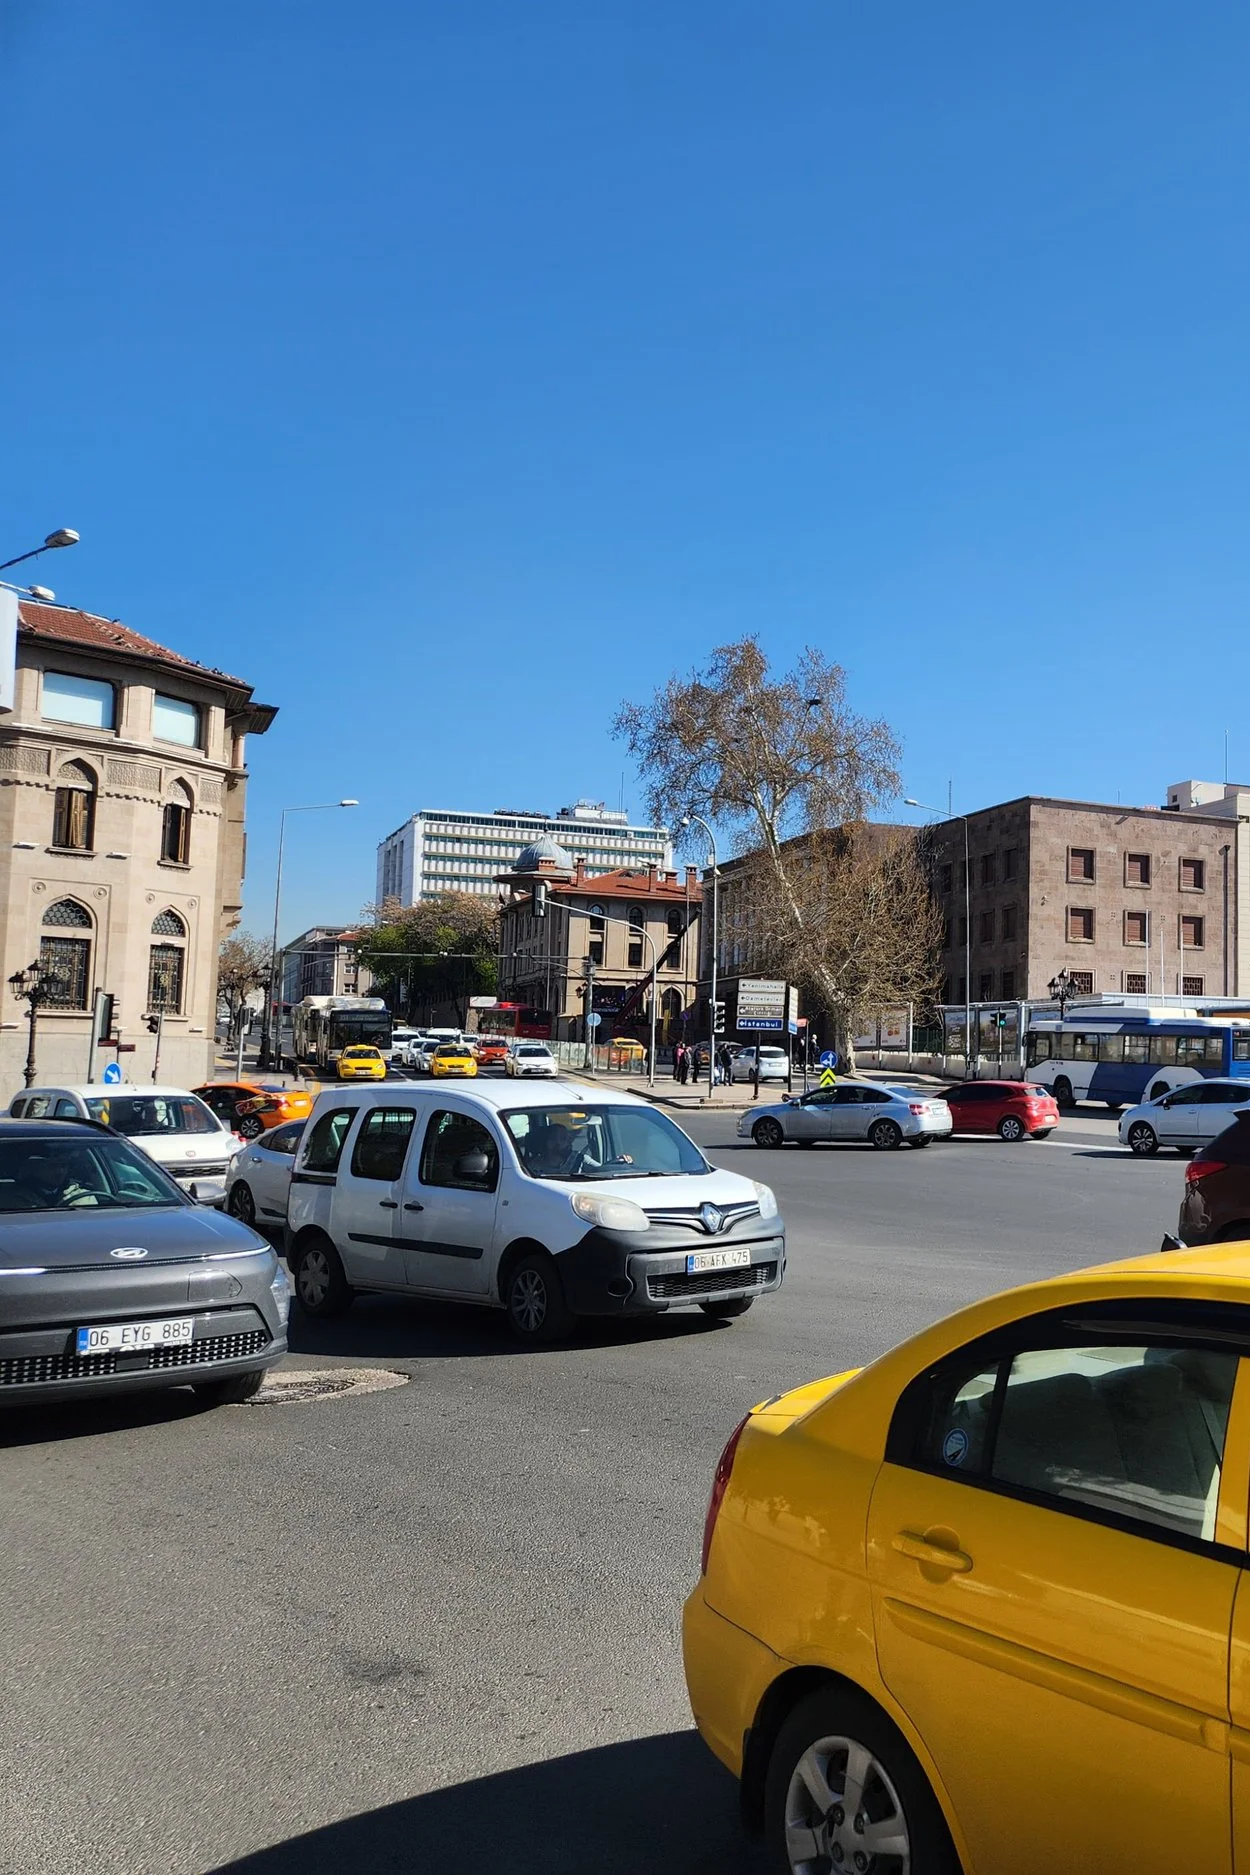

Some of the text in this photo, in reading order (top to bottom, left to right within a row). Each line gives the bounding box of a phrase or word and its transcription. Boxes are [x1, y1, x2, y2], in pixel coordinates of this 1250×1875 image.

[694, 1255, 706, 1268] 06
[89, 1321, 191, 1347] 06 EYG 885
